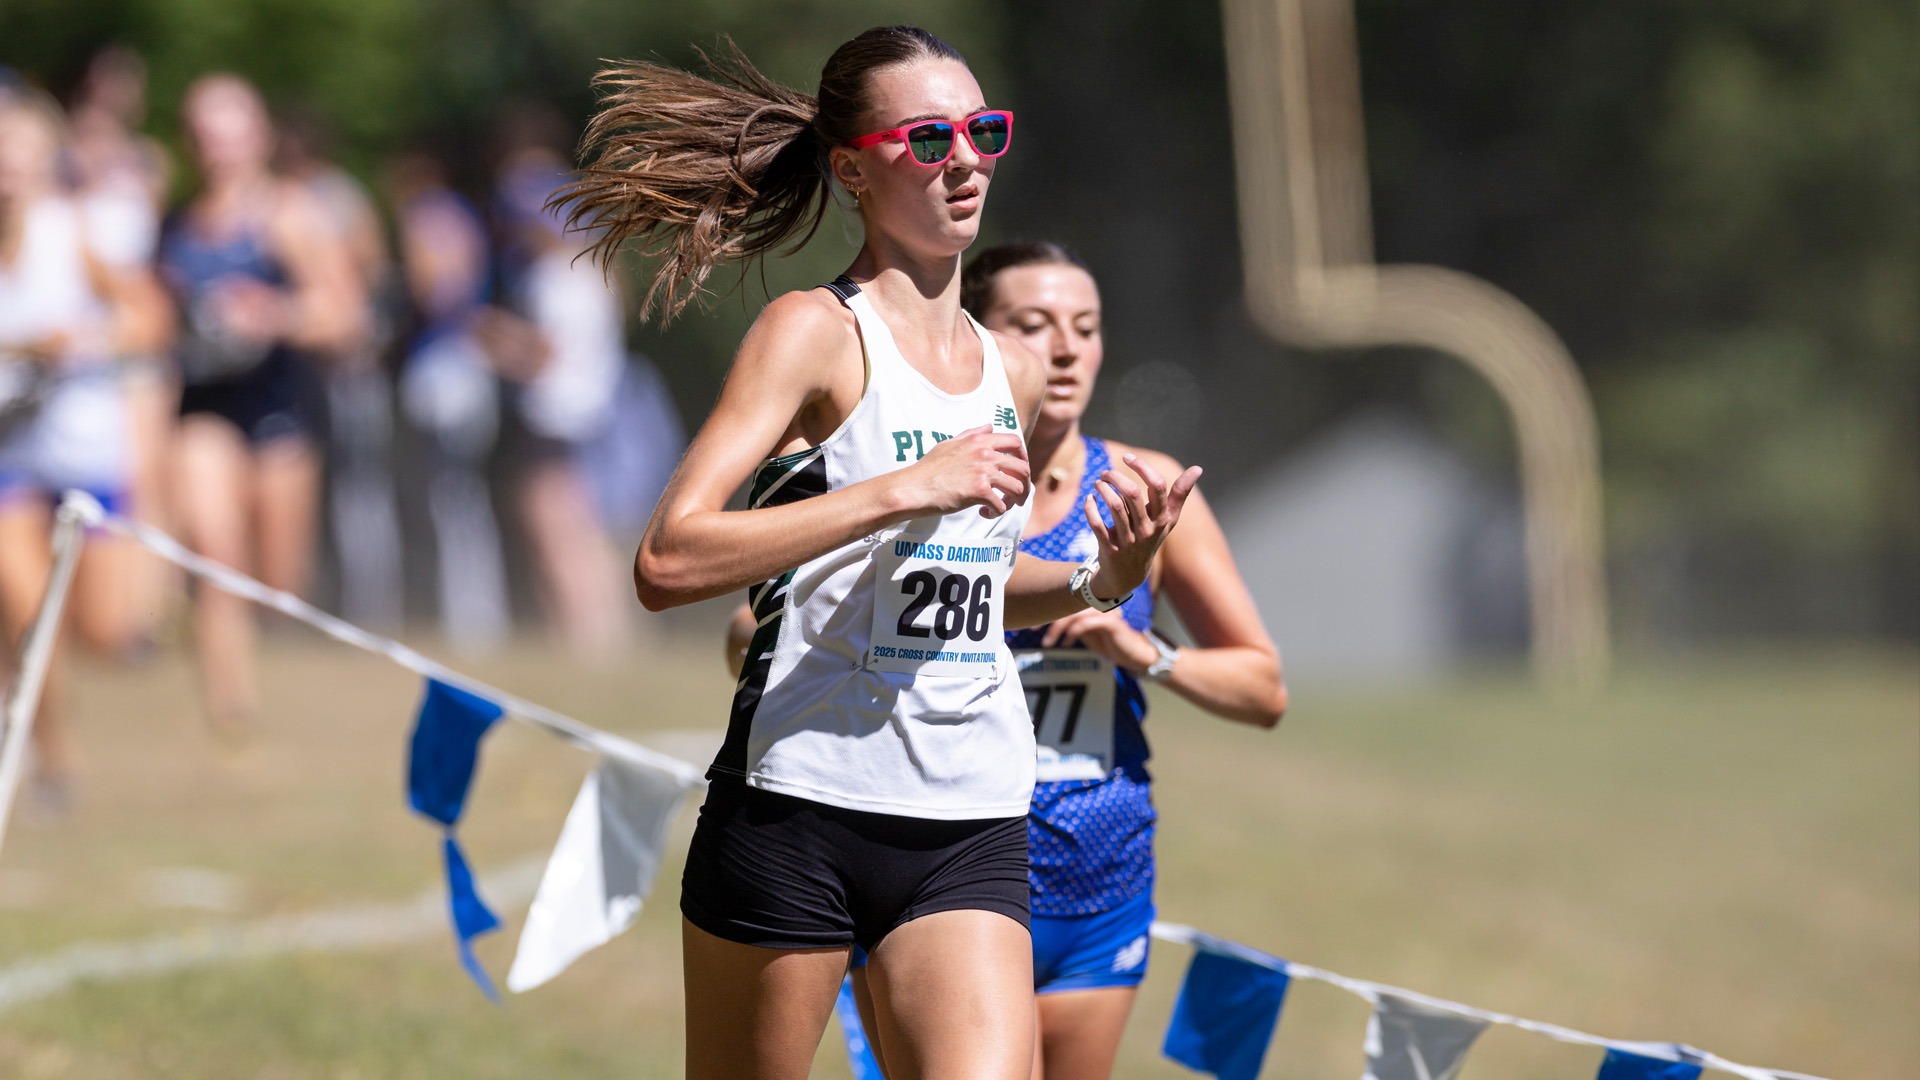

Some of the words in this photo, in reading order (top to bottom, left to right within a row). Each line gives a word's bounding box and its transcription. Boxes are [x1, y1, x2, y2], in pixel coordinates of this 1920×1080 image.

[895, 540, 944, 561] UMASS
[947, 545, 1002, 563] DARTMOUTH
[897, 571, 992, 641] 286
[874, 646, 896, 657] 2025
[898, 648, 924, 660] CROSS
[926, 650, 959, 662] COUNTRY
[960, 652, 996, 663] INVITATIONAL
